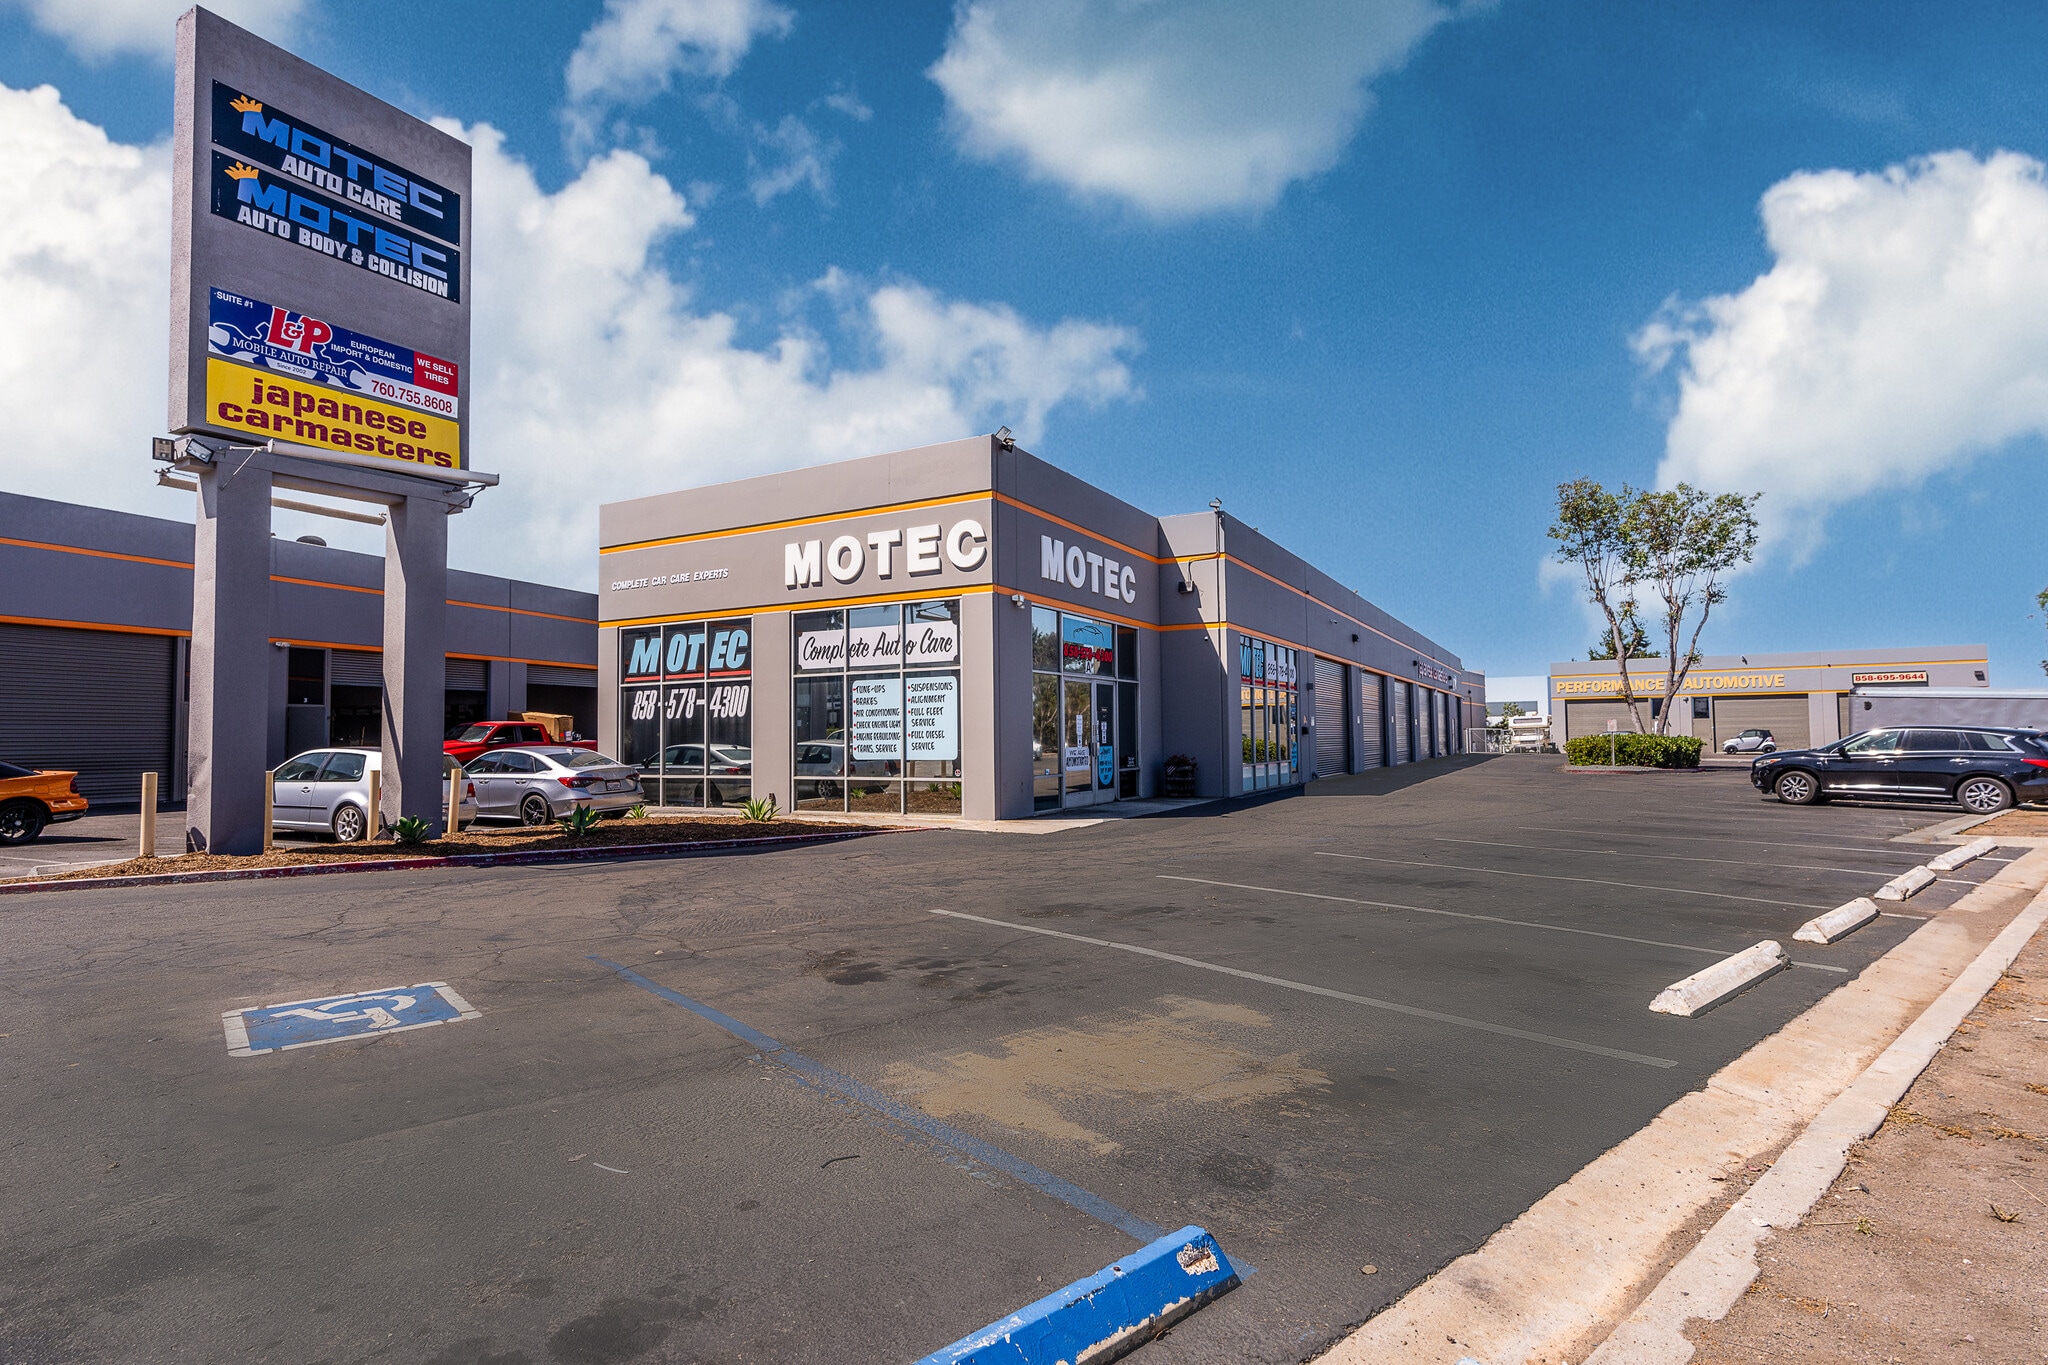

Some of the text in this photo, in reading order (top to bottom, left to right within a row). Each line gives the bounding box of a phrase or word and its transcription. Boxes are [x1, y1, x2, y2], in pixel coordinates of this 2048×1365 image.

[242, 111, 443, 219] MOTEC
[281, 154, 402, 221] AUTO CARE
[237, 178, 447, 280] MOTEC
[237, 205, 448, 298] AUTO BODY & COLLISION
[216, 291, 254, 309] SUITE #1
[265, 306, 332, 354] L&P
[232, 337, 348, 378] MOBILE AUTO REPAIR
[330, 343, 413, 373] IMPORT & DOMESTIC
[350, 340, 395, 360] EUROPEAN
[276, 362, 307, 375] Since 2002
[417, 357, 454, 376] WE SELL
[424, 371, 449, 385] TIRES
[371, 380, 452, 413] 760.755.8608
[251, 377, 427, 440] japanese
[218, 402, 452, 468] carmasters
[784, 519, 987, 590] MOTEC
[1040, 534, 1136, 604] MOTEC
[611, 568, 729, 591] COMPLETE CAR CARE EXPERTS
[628, 629, 748, 674] MOTEC
[803, 627, 953, 664] Complete Auto Care
[1683, 674, 1785, 690] AUTOMOTIVE
[1855, 673, 1924, 681] 858-695-9644
[856, 685, 886, 693] TUNE-UPS
[911, 682, 953, 692] SUSPENSIONS
[856, 697, 878, 705] BRAKES
[911, 694, 946, 704] ALIGNMENT
[856, 707, 900, 717] AIR CONDITIONING
[911, 706, 944, 716] FULL FLEET
[856, 721, 871, 729] CHECK
[871, 720, 889, 728] ENGINE
[911, 718, 935, 727] SERVICE
[856, 732, 873, 741] ENGINE
[911, 730, 945, 739] FULL DIESEL
[875, 744, 897, 753] SERVICE
[911, 742, 935, 751] SERVICE
